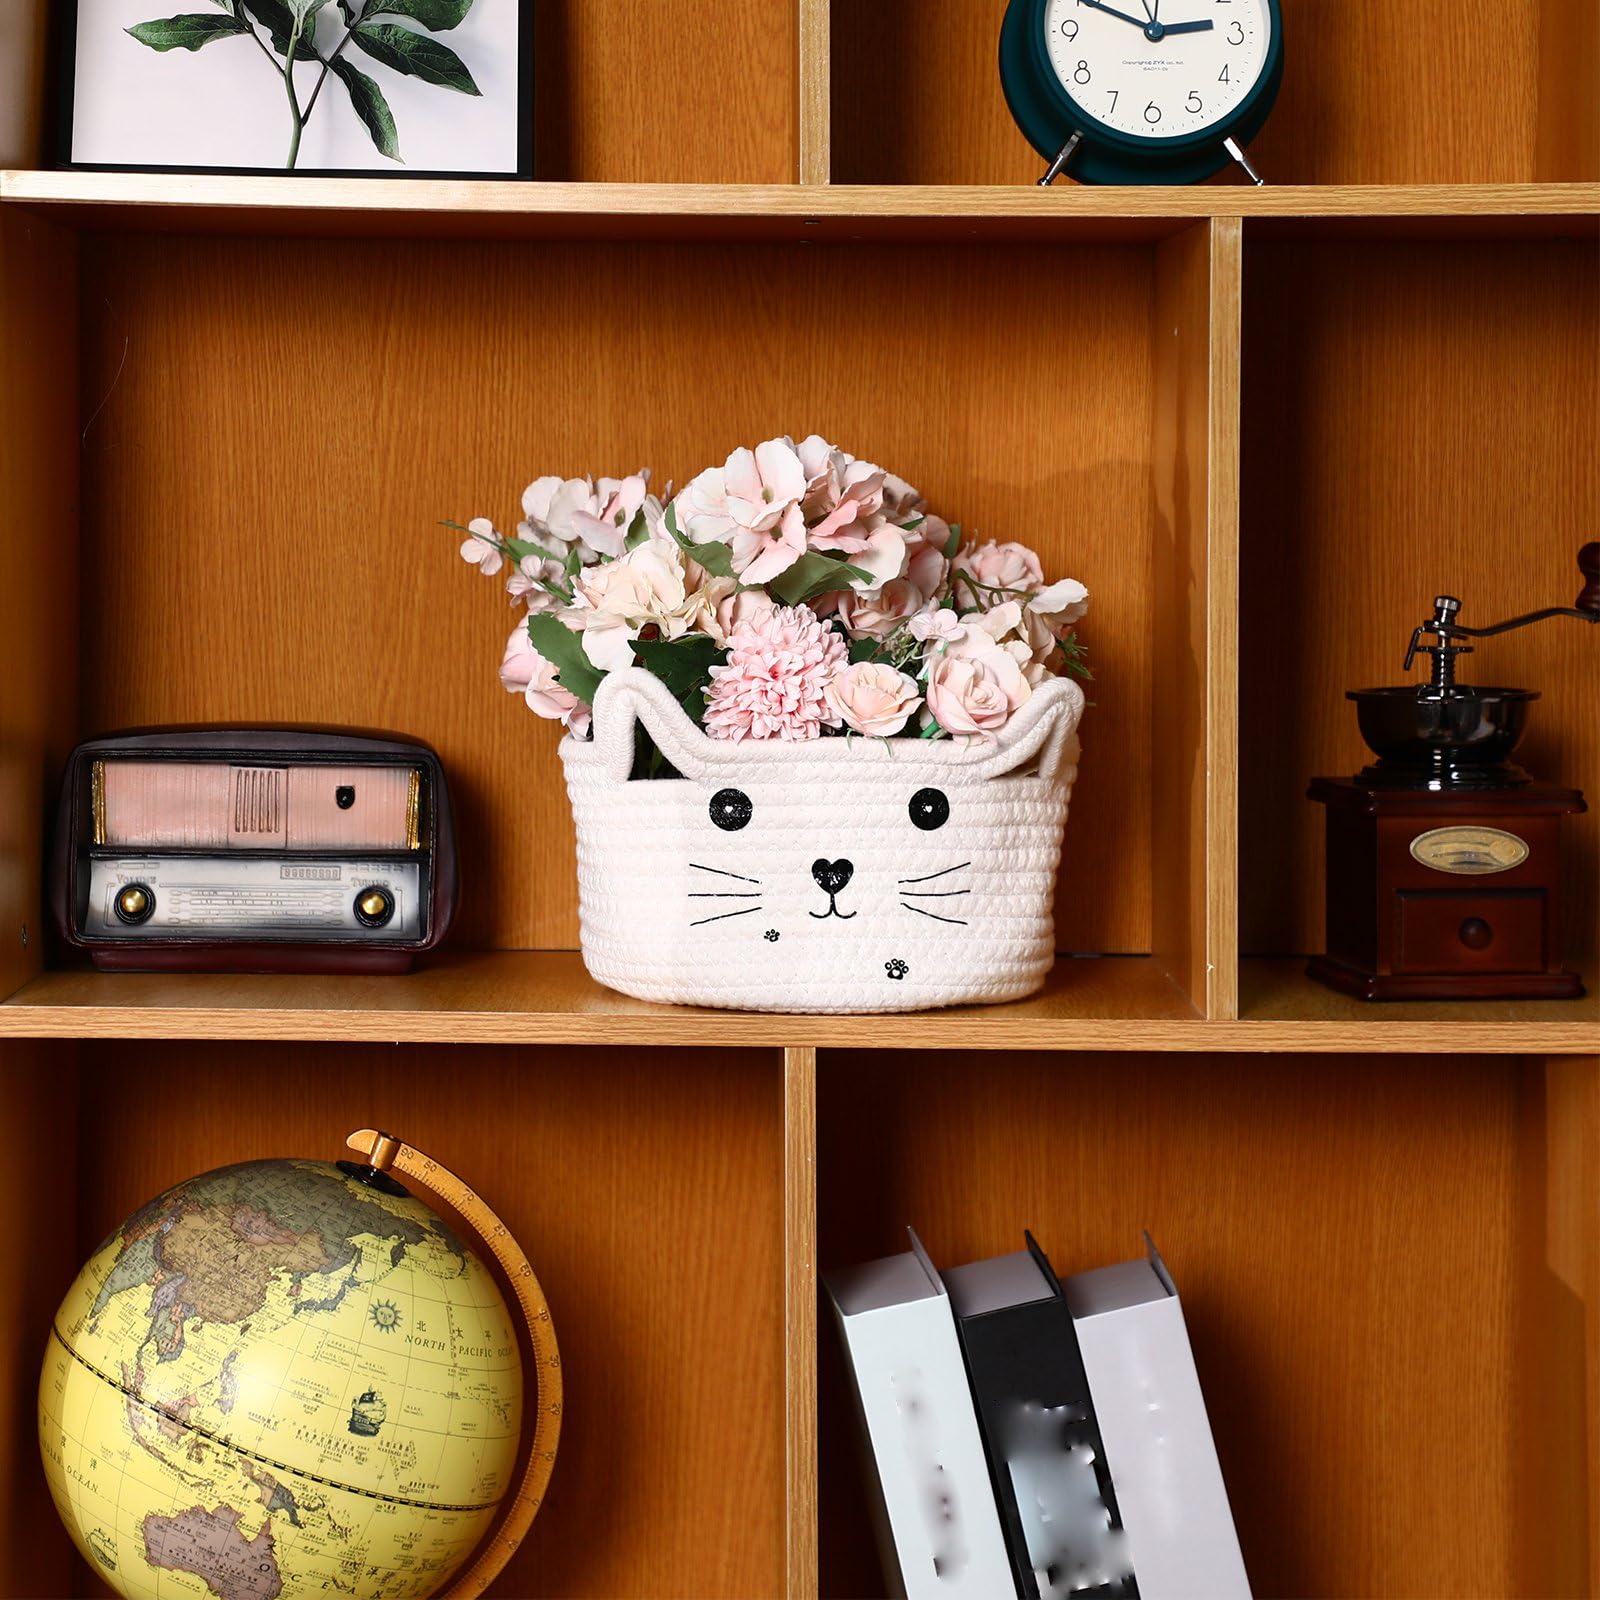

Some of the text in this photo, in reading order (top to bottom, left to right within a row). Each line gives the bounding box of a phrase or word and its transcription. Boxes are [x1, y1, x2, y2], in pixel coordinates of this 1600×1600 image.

[1061, 19, 1079, 42] 9
[1227, 21, 1245, 46] 3
[1074, 60, 1091, 84] 8
[1218, 63, 1231, 85] 4
[1107, 91, 1119, 113] 7
[1144, 100, 1162, 123] 6
[1185, 91, 1203, 113] 5
[400, 1147, 414, 1160] 90
[463, 1188, 475, 1201] 70
[404, 1334, 446, 1351] NORTH
[459, 1345, 493, 1358] PACIFIC
[65, 1465, 99, 1493] OCEAN
